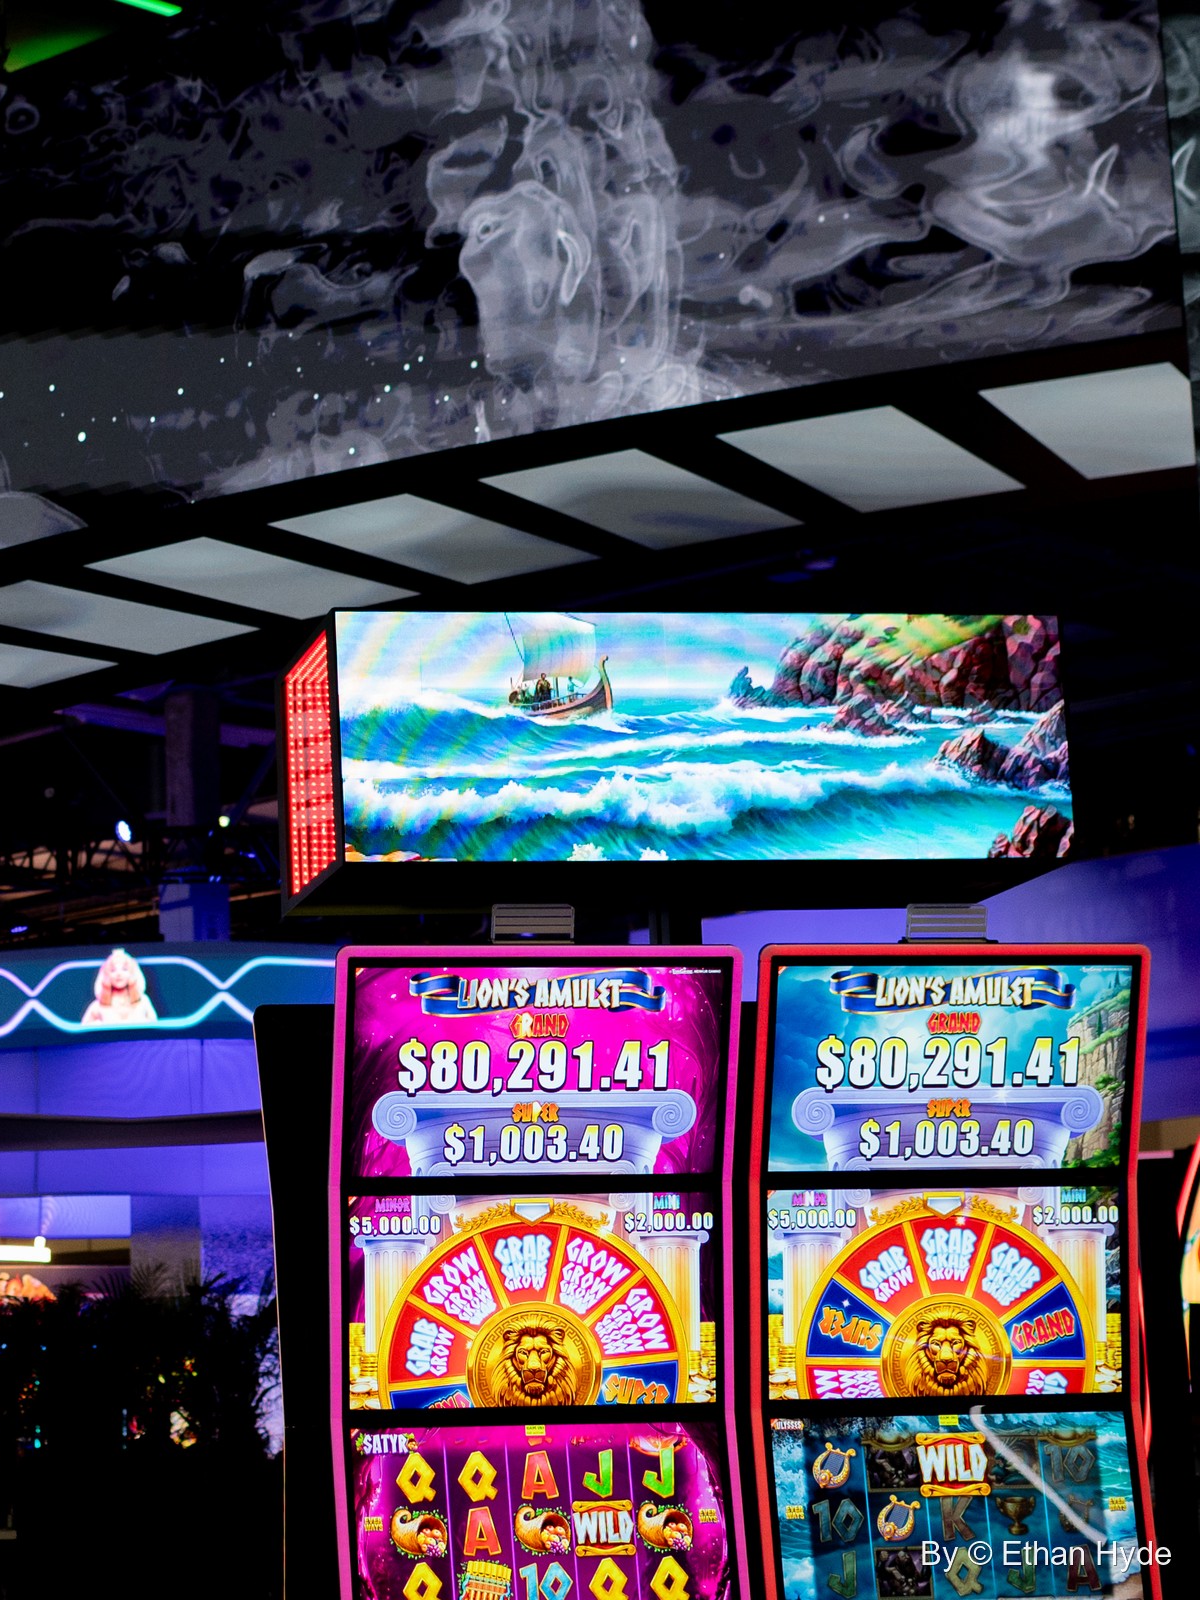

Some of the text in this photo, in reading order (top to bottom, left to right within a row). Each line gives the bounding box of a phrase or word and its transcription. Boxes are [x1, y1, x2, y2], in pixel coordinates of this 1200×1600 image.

[457, 977, 623, 1009] LION'S AMULET
[875, 975, 1035, 1007] LION'S AMULET
[509, 1012, 570, 1039] GRAND
[927, 1011, 982, 1035] GRAND
[398, 1038, 670, 1096] $80,291.41
[815, 1034, 1080, 1092] $80,291.41
[511, 1100, 560, 1124] SUPER
[927, 1098, 971, 1119] SUPER
[443, 1122, 624, 1166] $1,003.40
[858, 1118, 1035, 1159] $1,003.40
[374, 1198, 410, 1213] MINOR
[653, 1194, 680, 1210] MINI
[792, 1190, 827, 1207] MINOR
[1032, 1205, 1119, 1226] $2,000.00
[1061, 1189, 1087, 1203] MINI
[349, 1215, 441, 1236] $5,000.00
[624, 1212, 713, 1233] $2,000.00
[768, 1208, 856, 1230] $5,000.00
[494, 1234, 552, 1263] GRAB
[566, 1237, 631, 1286] GROW
[920, 1227, 977, 1255] GRAB
[423, 1246, 480, 1304] GROW
[562, 1262, 612, 1297] GROW
[858, 1245, 908, 1290] GRAB
[873, 1265, 914, 1303] GROW
[991, 1242, 1041, 1289] GRAB
[443, 1269, 489, 1315] GROW
[625, 1288, 669, 1350] GROW
[818, 1305, 883, 1352] SUPER
[1010, 1307, 1075, 1354] GRAND
[405, 1317, 439, 1377] GRAB
[429, 1326, 455, 1377] GROW
[602, 1373, 670, 1404] SUPER
[363, 1433, 409, 1454] SATYR
[917, 1443, 988, 1482] WILD
[1044, 1443, 1095, 1483] 10
[395, 1452, 436, 1504] Q
[457, 1451, 498, 1502] Q
[521, 1450, 559, 1500] A
[582, 1448, 613, 1498] J
[642, 1447, 675, 1498] J
[463, 1506, 501, 1556] A
[573, 1509, 634, 1545] WILD
[812, 1498, 865, 1542] 10
[939, 1496, 976, 1541] K
[402, 1562, 443, 1600] Q
[519, 1561, 573, 1600] 10
[588, 1557, 629, 1600] Q
[650, 1556, 690, 1600] Q
[827, 1550, 856, 1599] J
[945, 1547, 984, 1597] Q
[1007, 1547, 1036, 1593] J
[1067, 1544, 1101, 1592] A
